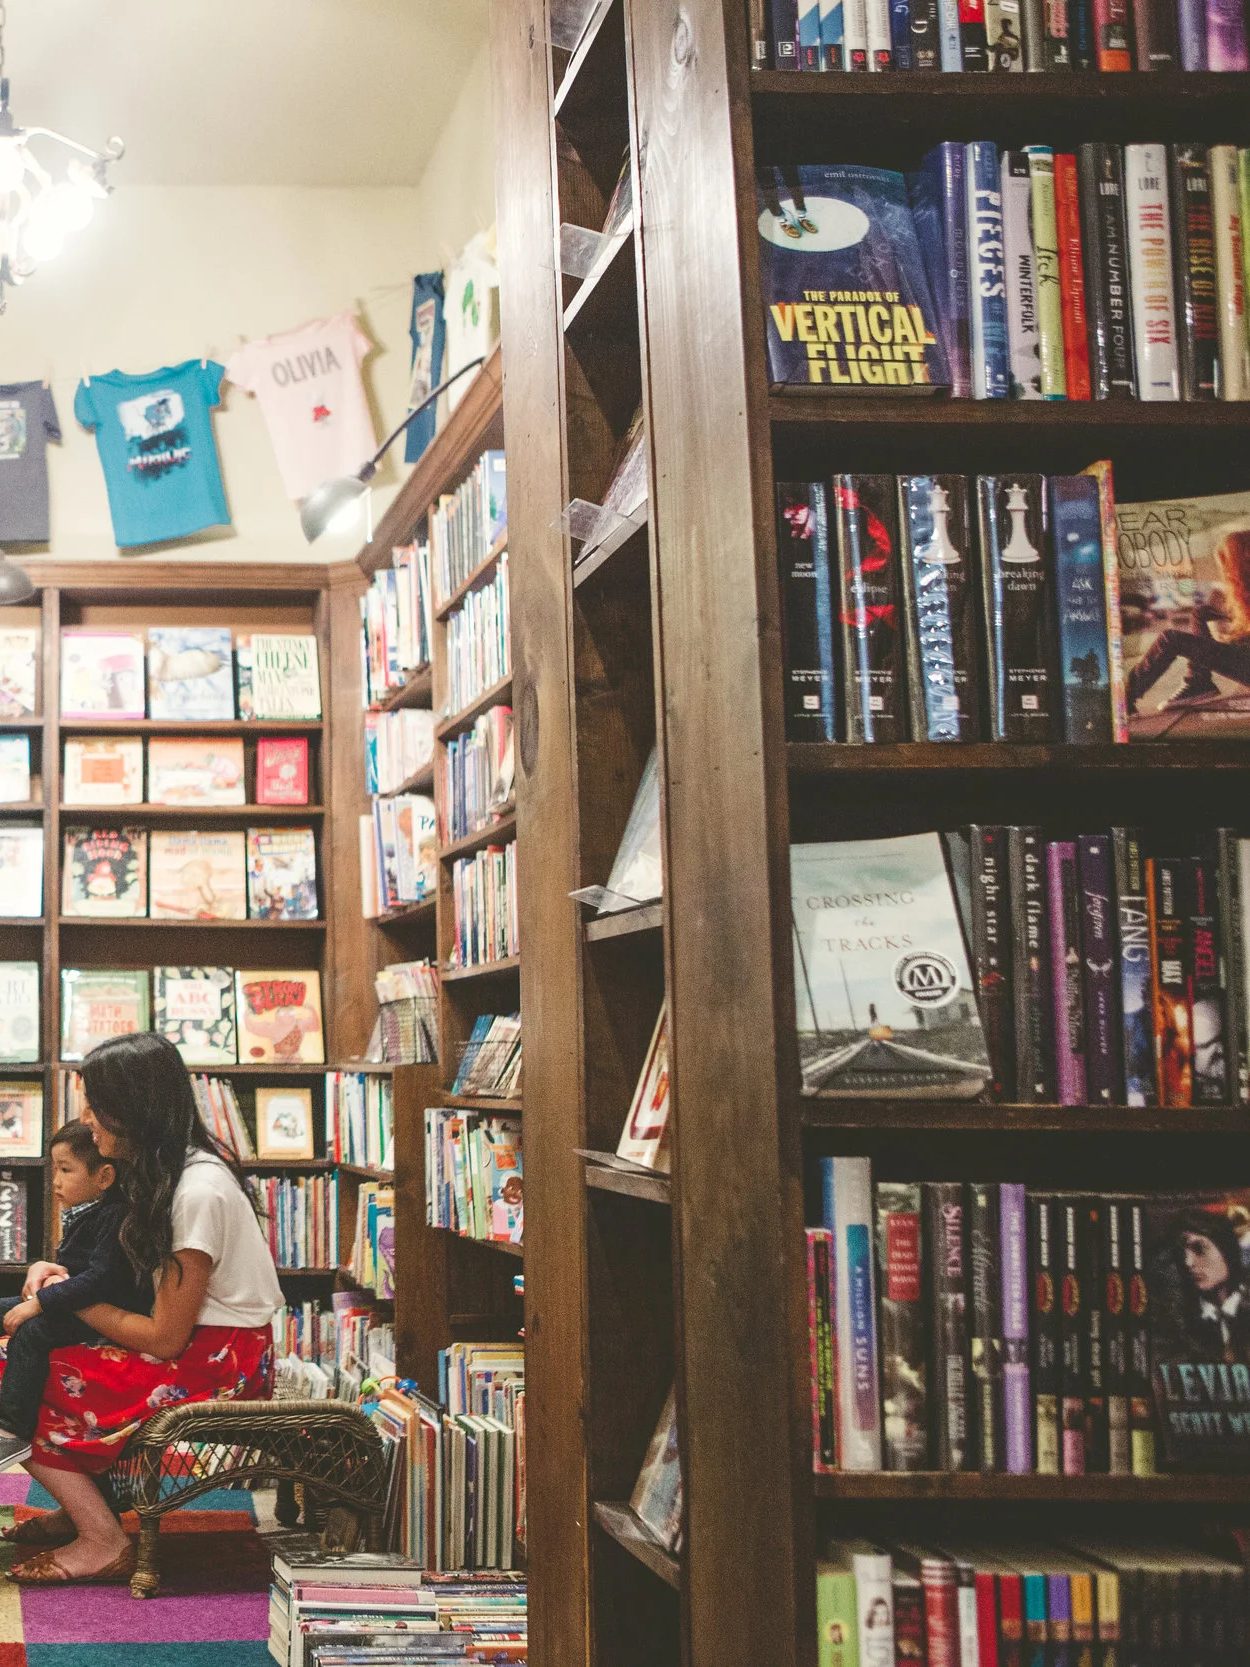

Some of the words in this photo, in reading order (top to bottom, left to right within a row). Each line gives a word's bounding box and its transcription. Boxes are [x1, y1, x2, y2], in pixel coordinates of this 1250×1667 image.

[1139, 204, 1164, 229] THE
[1188, 204, 1211, 231] THE
[974, 190, 1005, 298] PIECES
[1189, 237, 1213, 272] RISE
[1036, 245, 1059, 288] Itch
[1141, 237, 1168, 289] POWER
[803, 291, 826, 301] THE
[829, 291, 883, 303] PARADOX
[885, 292, 900, 303] OF
[1018, 254, 1034, 334] WINTERFOLK
[1107, 244, 1122, 320] NUMBER
[1192, 279, 1215, 297] OF
[1145, 295, 1169, 311] OF
[769, 303, 937, 345] VERTICAL
[1146, 319, 1170, 345] SIX
[1195, 304, 1217, 339] NINE
[806, 343, 931, 385] FLIGHT
[1112, 325, 1126, 369] FOUR
[271, 347, 342, 387] OLIVIA
[1118, 508, 1188, 532] EAR
[794, 562, 814, 570] new
[1117, 529, 1194, 570] OBODY
[998, 569, 1045, 582] breaking
[1007, 581, 1037, 591] dawn
[981, 857, 1000, 902] night
[1026, 853, 1041, 892] dark
[806, 892, 916, 911] CROSSING
[1084, 890, 1110, 940] forgiven
[854, 917, 875, 927] the
[986, 911, 1000, 944] star
[1027, 900, 1043, 949] flame
[823, 934, 914, 953] TRACKS
[1193, 929, 1216, 980] ANGEL
[909, 965, 943, 987] M
[1161, 959, 1182, 984] MAX
[174, 992, 211, 1004] ABC
[943, 1202, 963, 1277] SILENCE
[855, 1336, 870, 1391] SUNS
